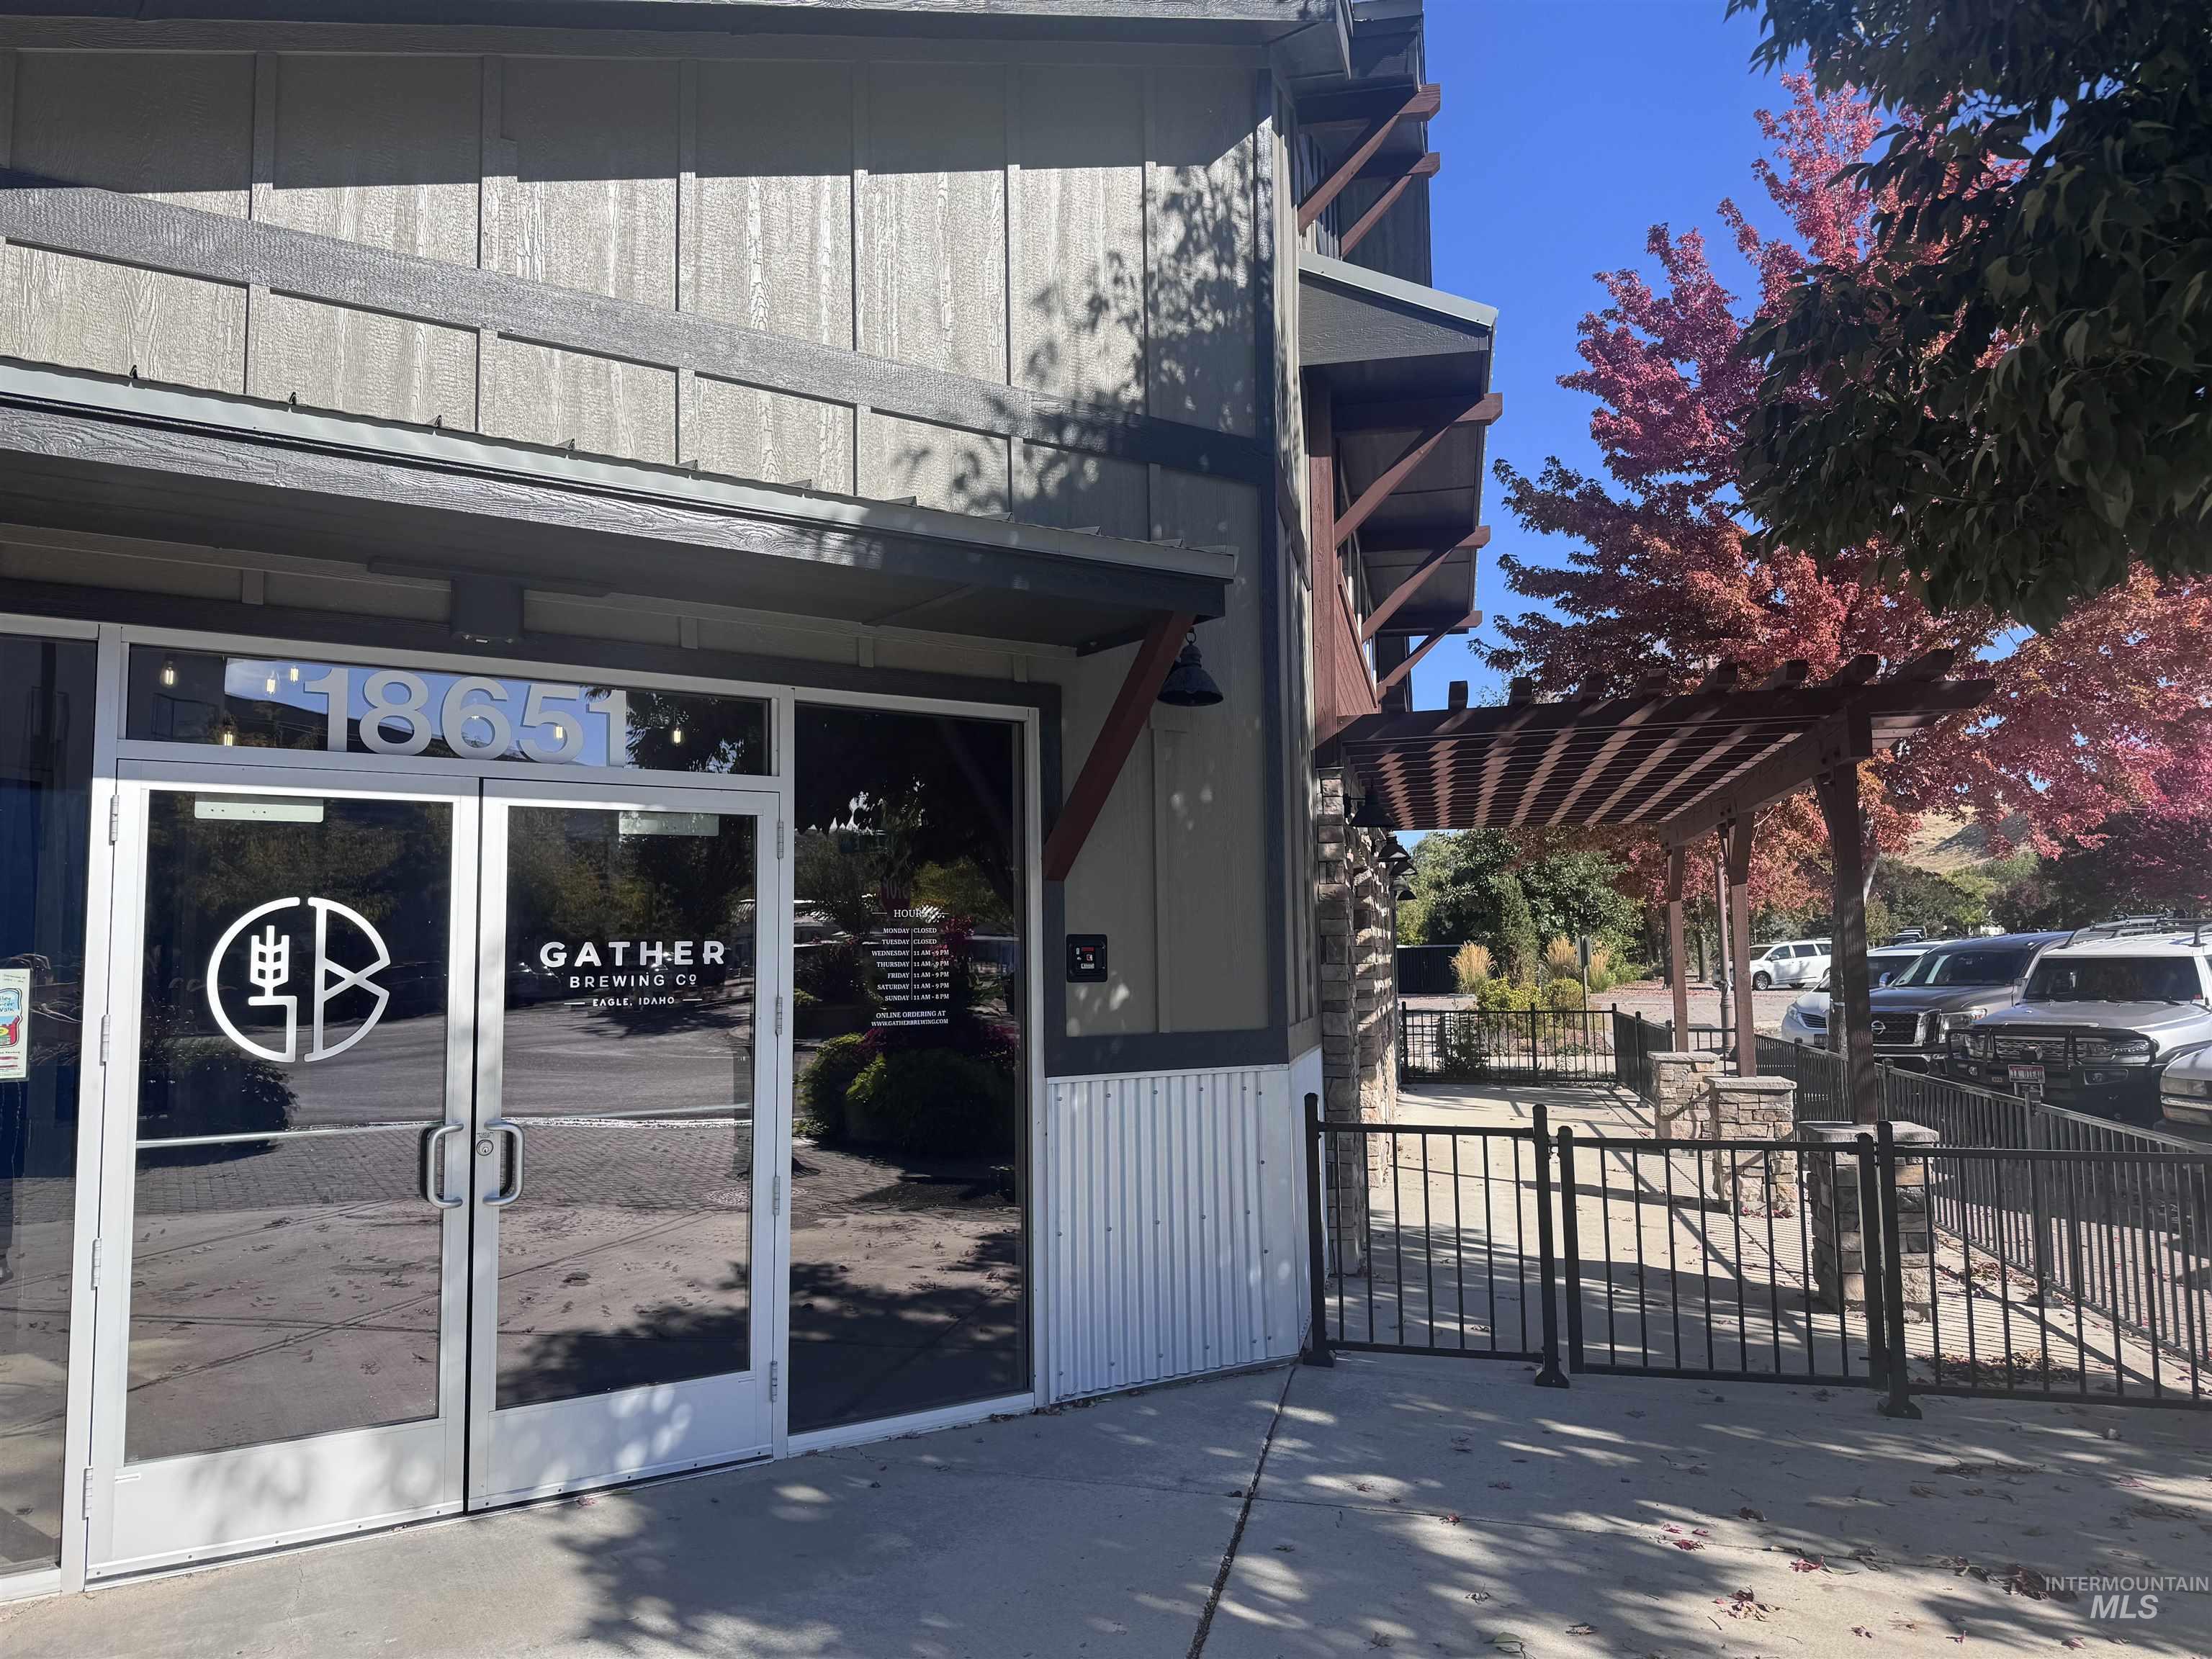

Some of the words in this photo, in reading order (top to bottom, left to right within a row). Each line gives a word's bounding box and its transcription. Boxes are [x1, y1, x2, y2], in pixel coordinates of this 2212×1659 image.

[304, 667, 628, 768] 18651
[539, 940, 725, 968] GATHER
[570, 974, 665, 988] BREWING
[639, 996, 675, 1006] IDAHO
[871, 1018, 948, 1027] WWW.GATHERBREWING.COM
